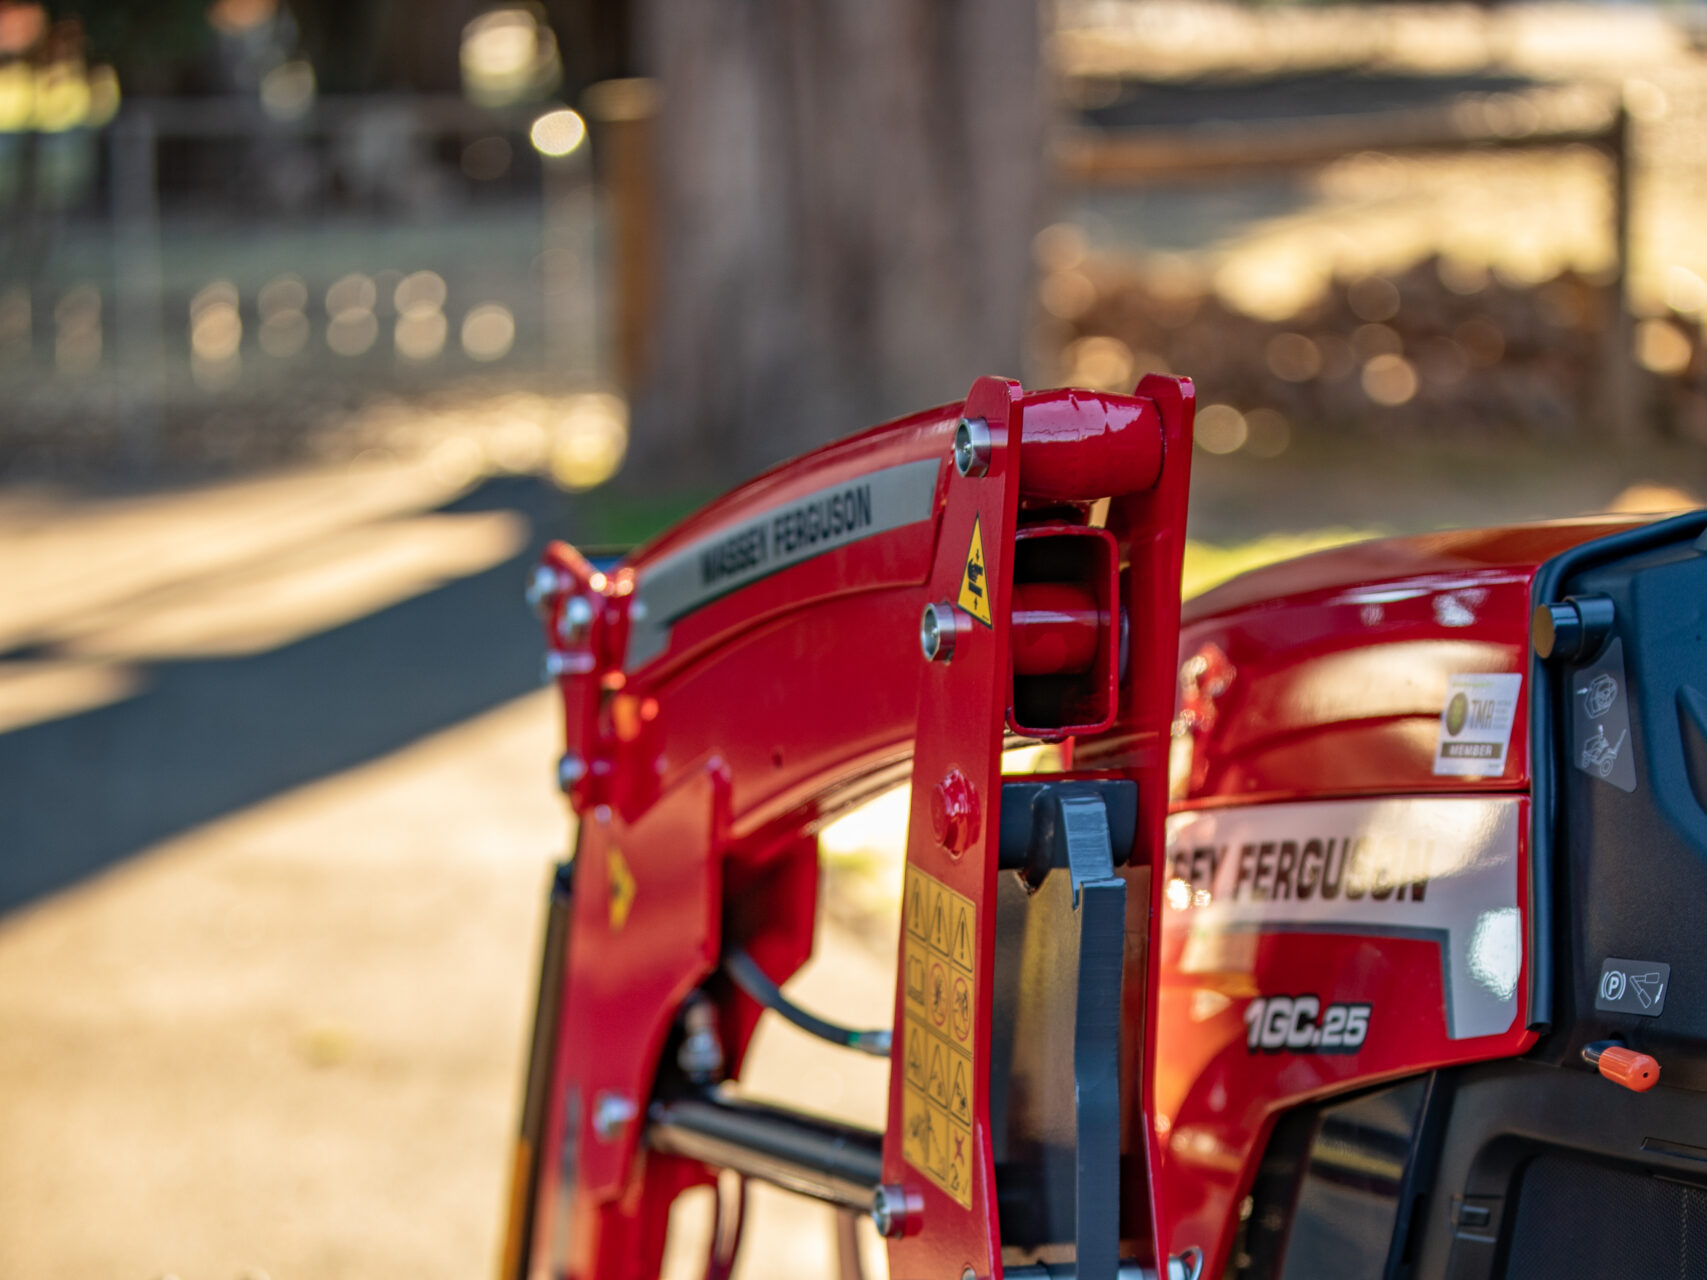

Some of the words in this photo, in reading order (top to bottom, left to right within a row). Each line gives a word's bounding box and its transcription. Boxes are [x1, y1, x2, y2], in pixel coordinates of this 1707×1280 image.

[703, 521, 769, 583] MASSEY
[774, 484, 872, 557] FERGUSON
[1448, 744, 1493, 757] MEMBER
[1244, 995, 1372, 1051] 1GC.25
